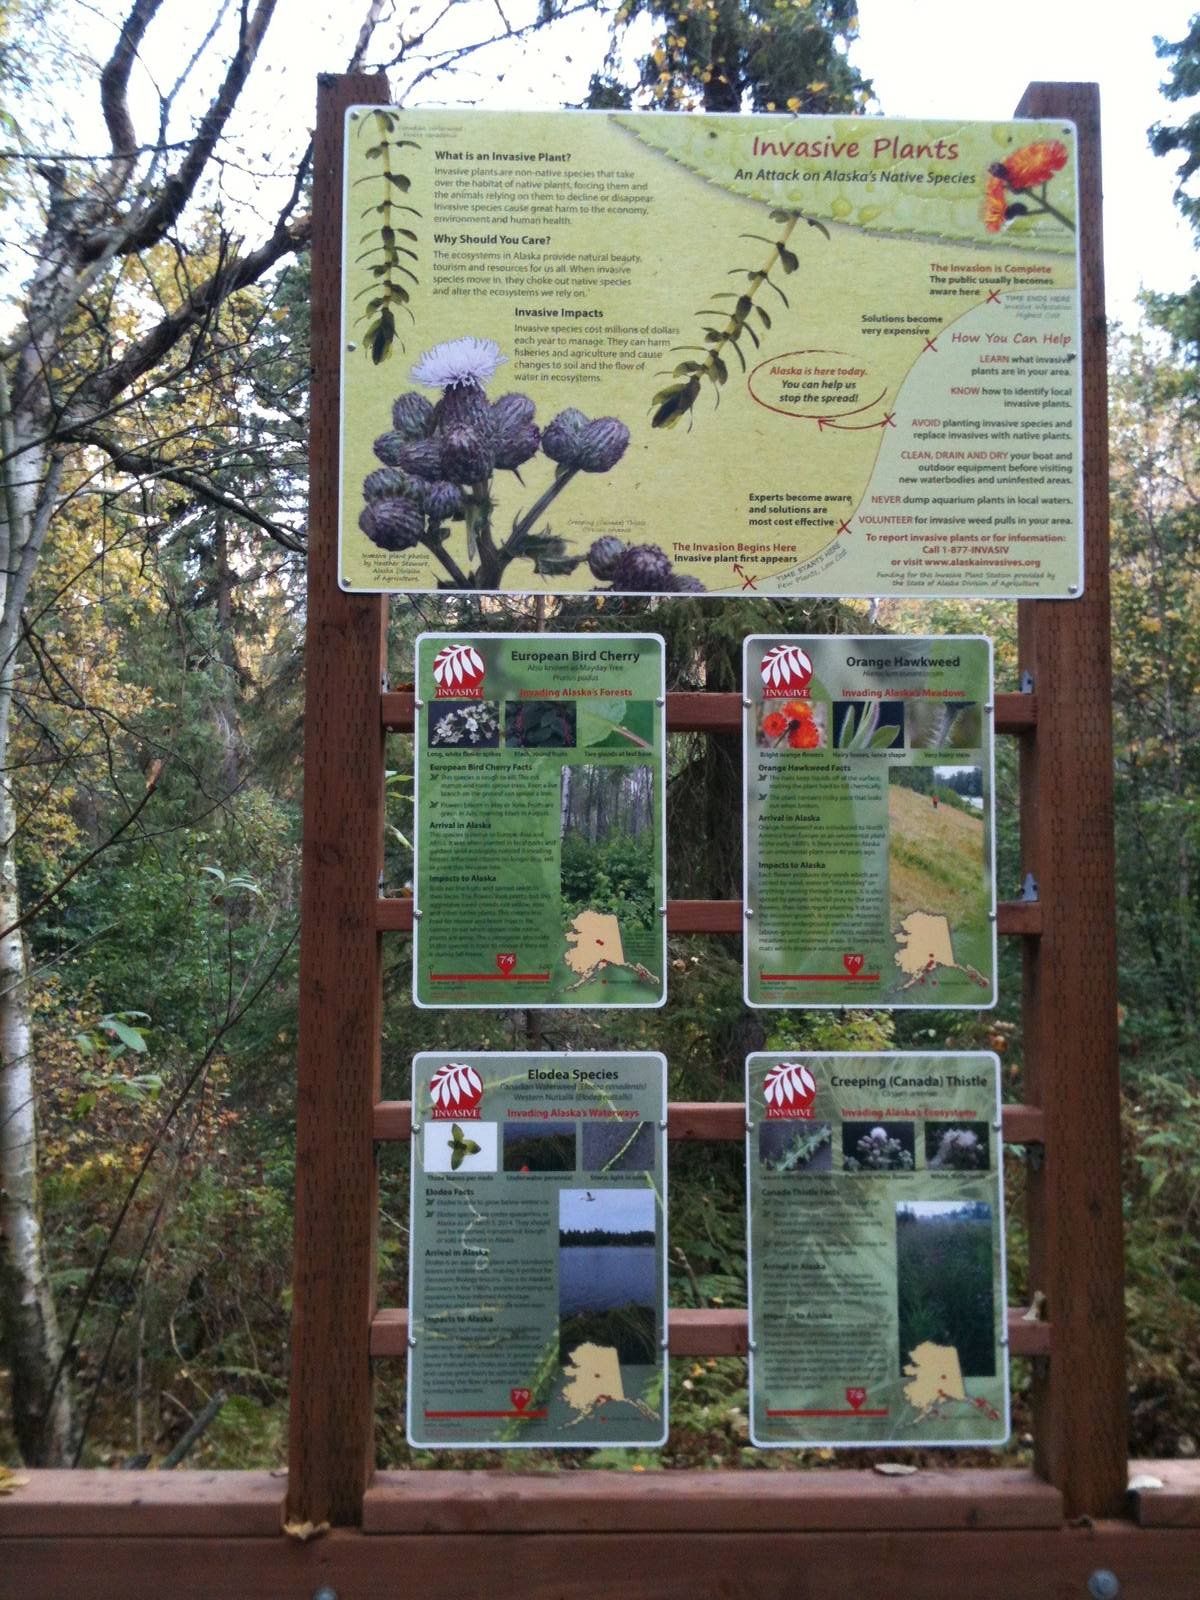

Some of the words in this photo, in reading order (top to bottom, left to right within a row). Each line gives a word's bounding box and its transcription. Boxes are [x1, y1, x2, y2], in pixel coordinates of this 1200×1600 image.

[752, 136, 860, 159] Invasive
[872, 137, 959, 161] Plants
[435, 151, 464, 162] What
[465, 151, 475, 162] is
[476, 154, 490, 163] an
[491, 152, 536, 163] Invasive
[537, 152, 572, 163] Plant?
[734, 168, 754, 181] An
[755, 169, 800, 182] Attack
[802, 172, 821, 182] on
[823, 170, 877, 183] Alaska's
[880, 170, 924, 183] Native
[927, 171, 976, 187] Species
[433, 234, 458, 248] Why
[459, 234, 498, 245] Should
[499, 234, 520, 246] You
[521, 235, 551, 246] Care?
[433, 251, 450, 260] The
[451, 251, 502, 263] ecosystems
[502, 252, 512, 261] in
[513, 252, 542, 261] Alaska
[542, 252, 577, 264] provide
[577, 252, 610, 262] natural
[930, 263, 949, 273] The
[950, 263, 993, 274] Invasion
[994, 264, 1003, 274] is
[1004, 264, 1052, 276] Complete
[930, 275, 947, 285] The
[948, 275, 977, 287] public
[978, 275, 1012, 287] usually
[1013, 276, 1054, 285] becomes
[958, 287, 981, 296] here
[514, 307, 559, 318] Invasive
[560, 308, 604, 321] Impacts
[861, 314, 905, 324] Solutions
[906, 314, 944, 324] become
[514, 324, 550, 334] Invasive
[550, 324, 583, 336] species
[584, 325, 603, 334] cost
[604, 325, 639, 334] millions
[639, 325, 650, 335] of
[650, 325, 680, 335] dollars
[861, 328, 882, 337] very
[883, 326, 930, 338] expensive
[951, 332, 981, 344] How
[986, 332, 1008, 344] You
[1012, 332, 1038, 345] Can
[1042, 333, 1072, 348] Help
[979, 354, 1010, 364] LEARN
[1011, 354, 1034, 364] what
[769, 366, 803, 376] Alaska
[804, 366, 813, 376] is
[813, 367, 836, 376] here
[837, 367, 868, 379] today.
[971, 367, 1000, 378] plants
[1016, 367, 1026, 376] in
[1027, 369, 1048, 378] your
[782, 379, 800, 389] You
[821, 379, 844, 391] help
[779, 393, 802, 405] stop
[803, 393, 820, 403] the
[821, 393, 859, 405] spread!
[950, 387, 980, 396] KNOW
[981, 387, 1002, 396] how
[1002, 387, 1014, 396] to
[1014, 387, 1049, 399] identify
[1050, 388, 1073, 397] local
[1003, 400, 1041, 408] invasive
[1041, 400, 1072, 410] plants.
[748, 492, 784, 504] Experts
[785, 493, 823, 502] become
[824, 495, 853, 503] aware
[748, 505, 767, 514] and
[768, 505, 811, 514] solutions
[748, 517, 773, 526] most
[773, 517, 793, 526] cost
[794, 517, 835, 527] effective
[866, 534, 878, 542] To
[878, 534, 909, 544] report
[909, 534, 948, 542] invasive
[949, 534, 979, 544] plants
[992, 534, 1007, 542] for
[1007, 534, 1067, 542] information:
[673, 542, 691, 552] The
[692, 542, 735, 552] Invasion
[736, 543, 771, 554] Begins
[772, 543, 797, 552] Here
[922, 545, 941, 554] Call
[673, 553, 712, 563] Invasive
[713, 553, 739, 565] plant
[739, 553, 759, 563] first
[760, 556, 798, 565] appears
[903, 558, 923, 566] visit
[924, 558, 1041, 569] www.alaskainvasives.org
[510, 651, 570, 664] European
[571, 651, 597, 661] Bird
[599, 651, 641, 664] Cherry
[846, 657, 892, 669] Orange
[893, 657, 961, 667] Hawkweed
[527, 1070, 570, 1080] Elodea
[572, 1070, 619, 1082] Species
[830, 1077, 887, 1089] Creeping
[889, 1077, 944, 1089] (Canada)
[947, 1077, 988, 1087] Thistle
[768, 1109, 812, 1117] INVASIVE
